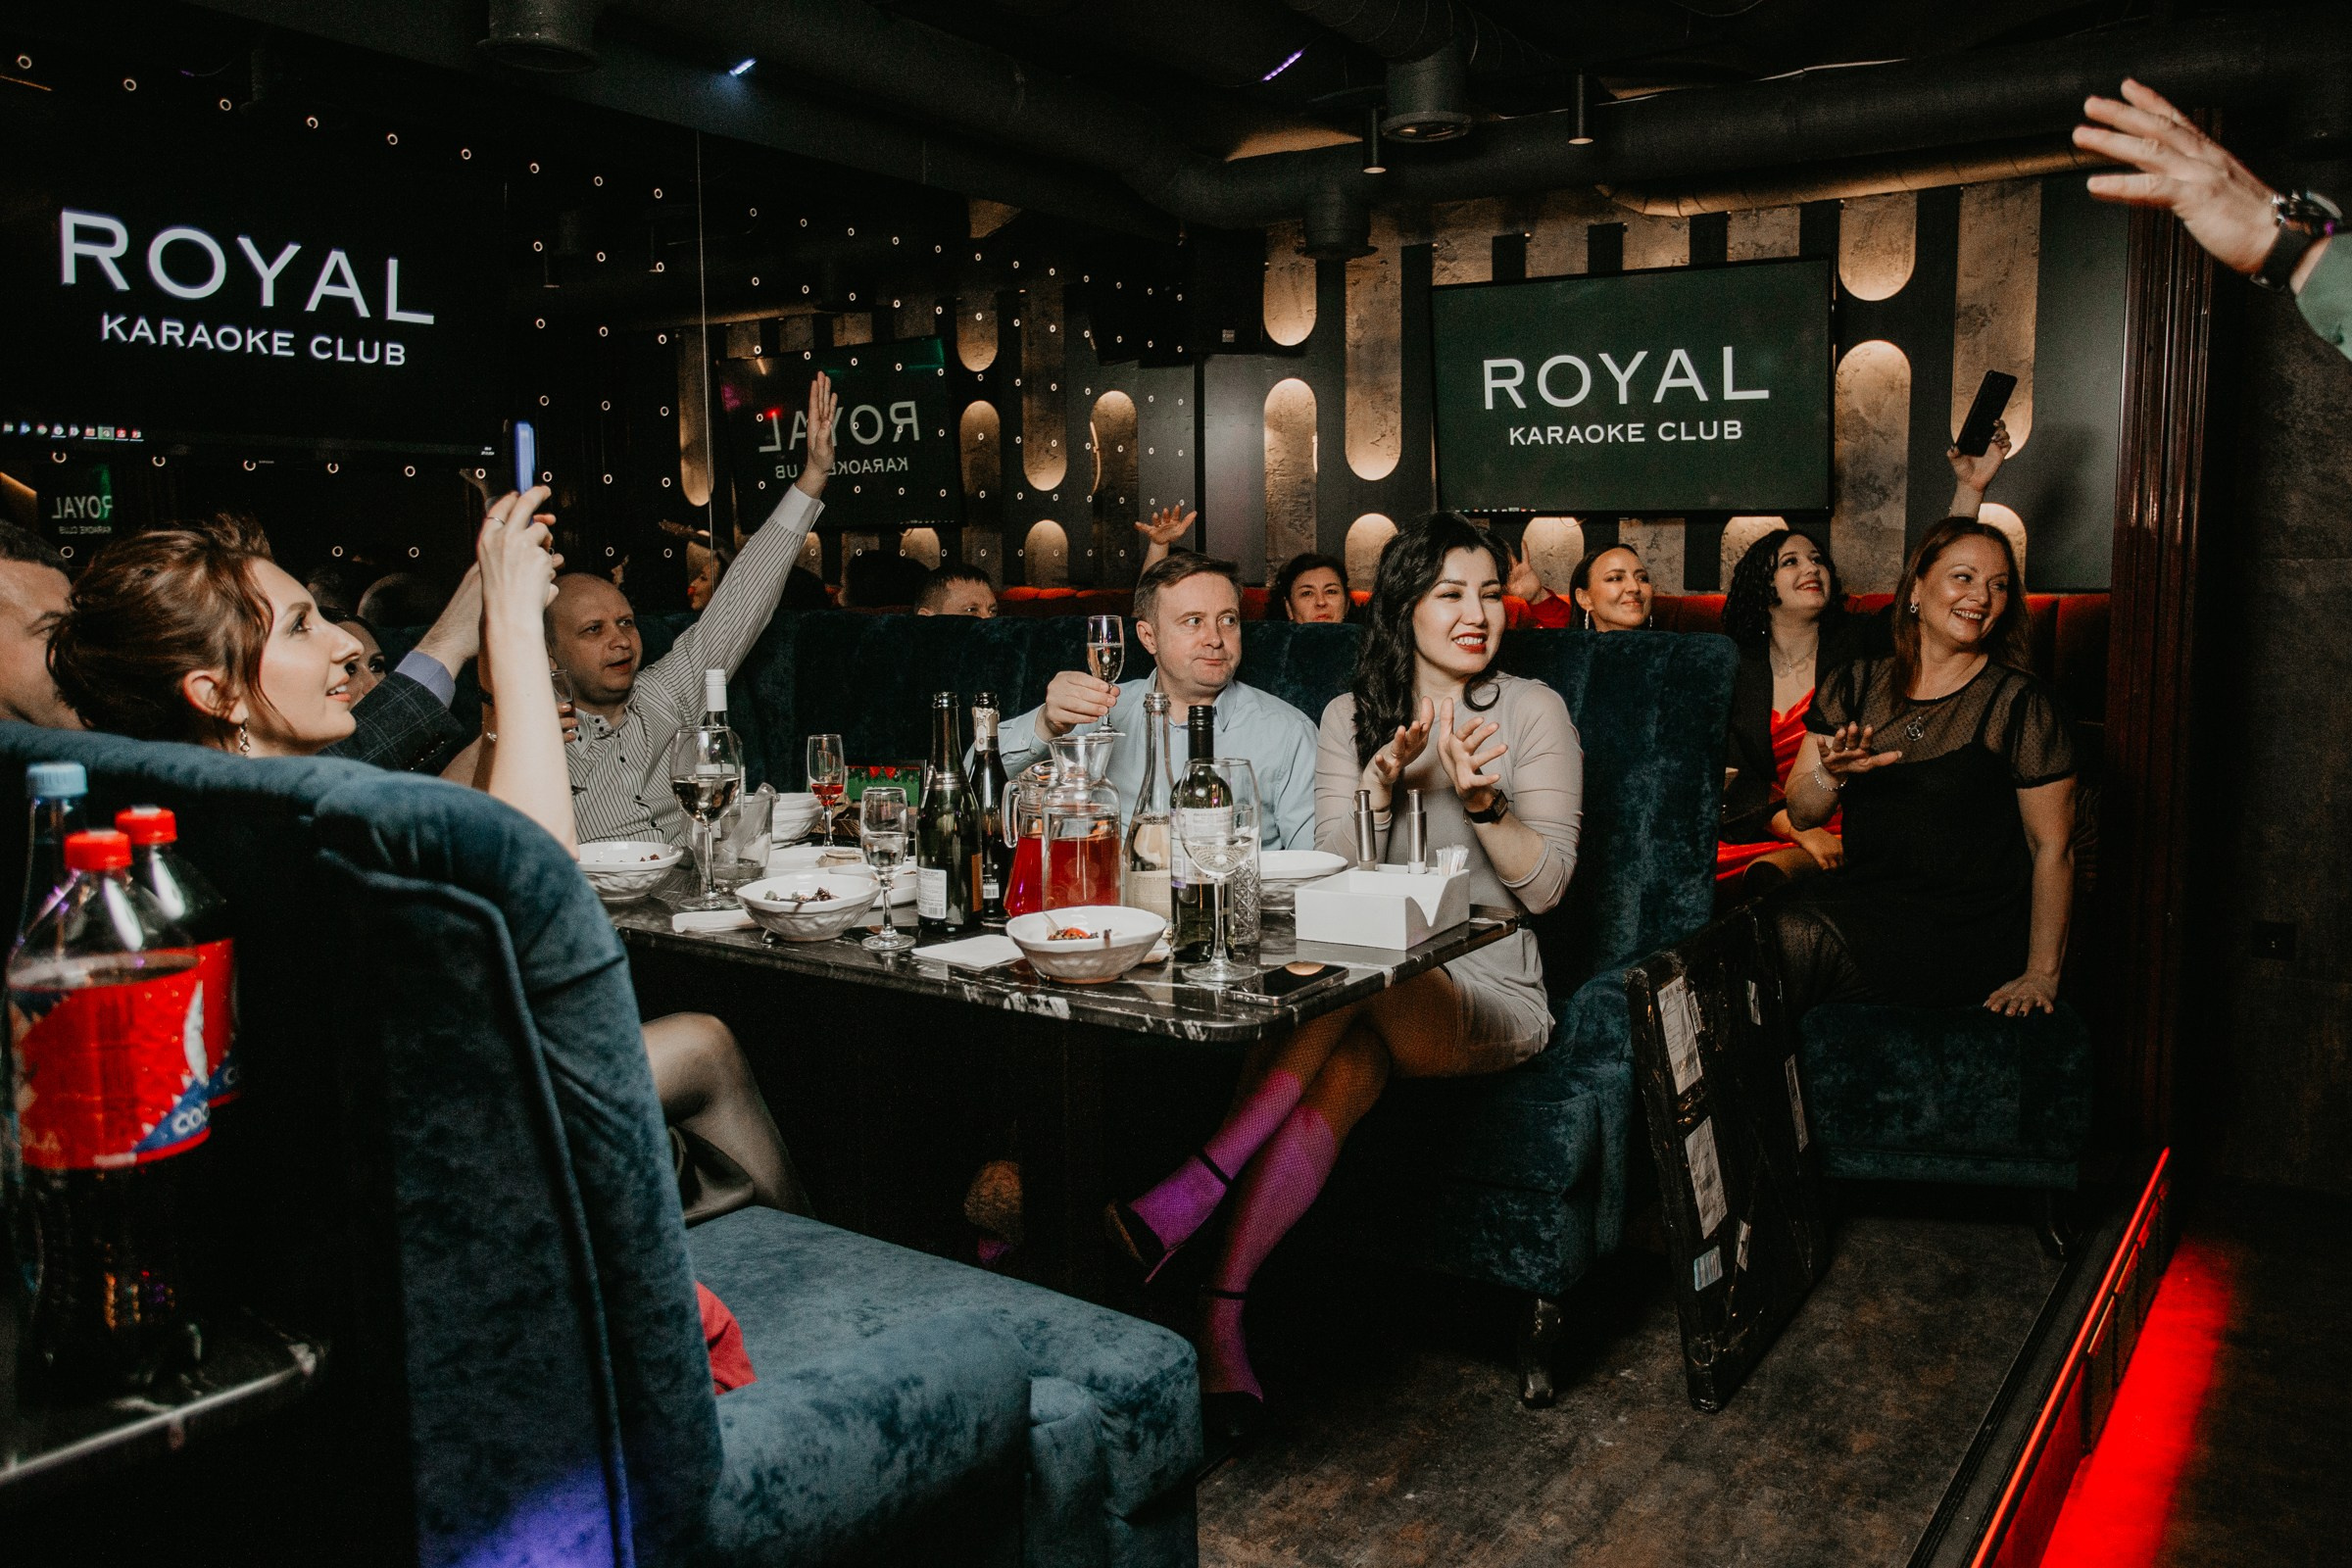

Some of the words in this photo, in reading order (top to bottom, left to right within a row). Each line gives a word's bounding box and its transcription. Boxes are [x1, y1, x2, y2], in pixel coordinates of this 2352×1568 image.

[61, 209, 435, 325] ROYAL
[101, 313, 295, 358] KARAOKE
[310, 334, 407, 367] CLUB
[1483, 346, 1770, 411] ROYAL
[1509, 422, 1645, 446] KARAOKE
[1657, 419, 1742, 442] CLUB
